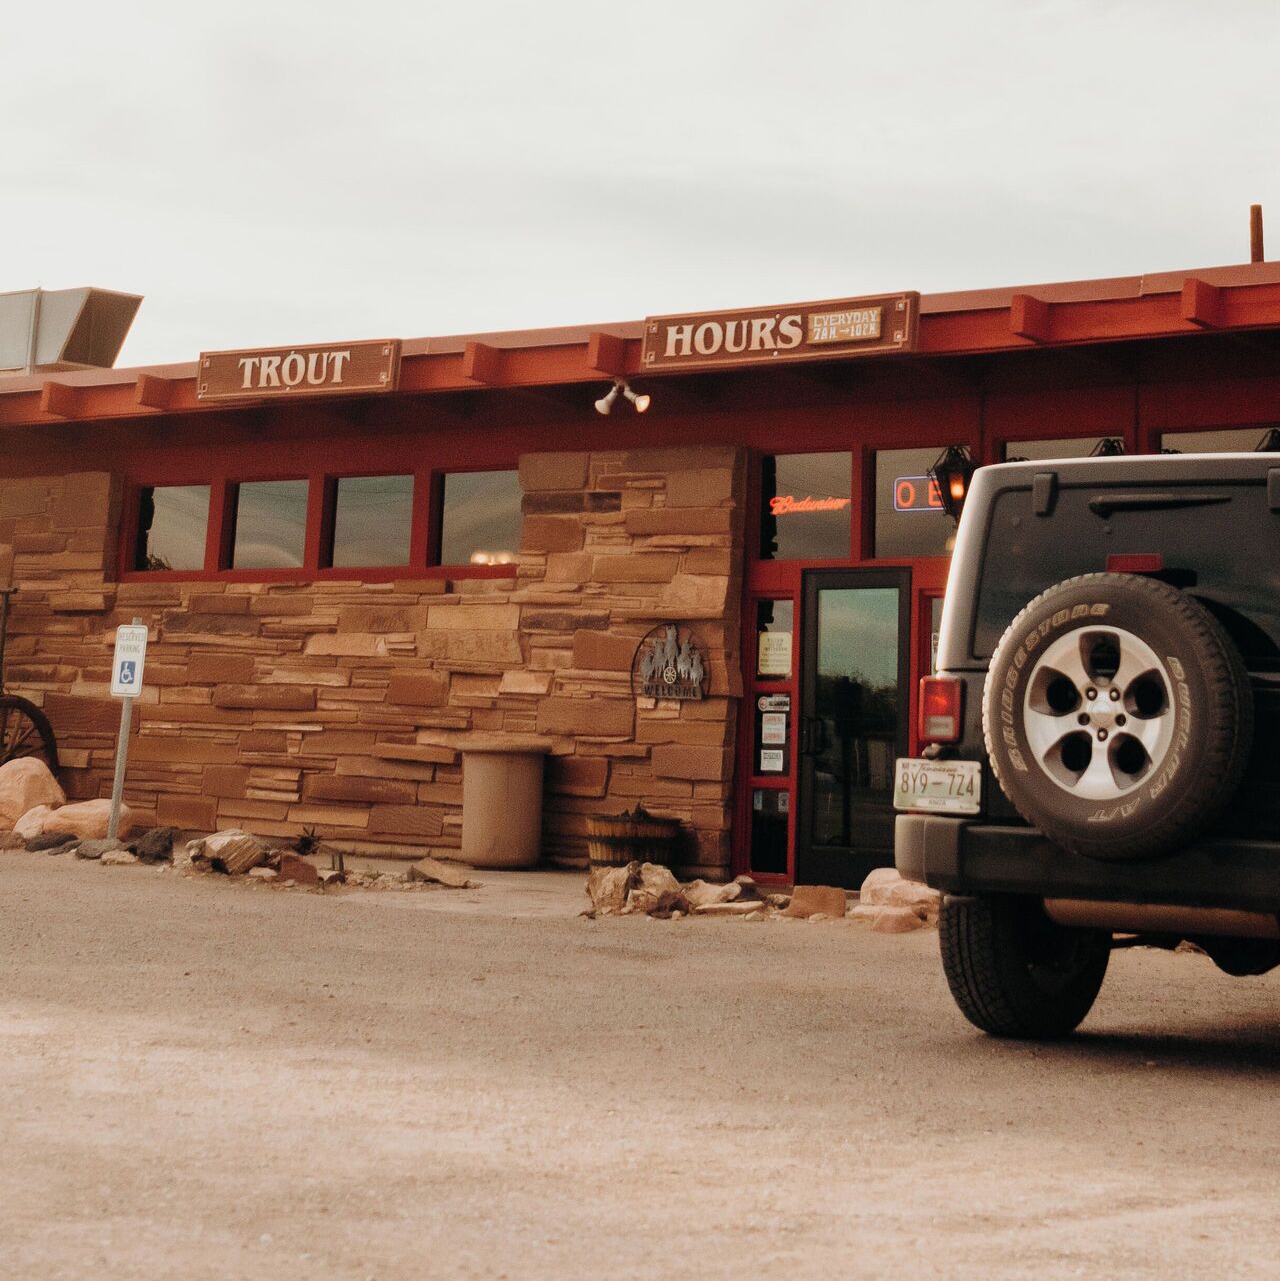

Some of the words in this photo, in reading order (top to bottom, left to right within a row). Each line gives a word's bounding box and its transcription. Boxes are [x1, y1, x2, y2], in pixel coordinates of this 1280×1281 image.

[813, 310, 878, 328] EVERYDAY
[664, 314, 803, 357] HOURS
[238, 350, 351, 389] TROUT
[770, 495, 852, 516] Budweiser
[644, 684, 698, 697] WELCOME
[1001, 603, 1112, 772] BRIDGESTONE
